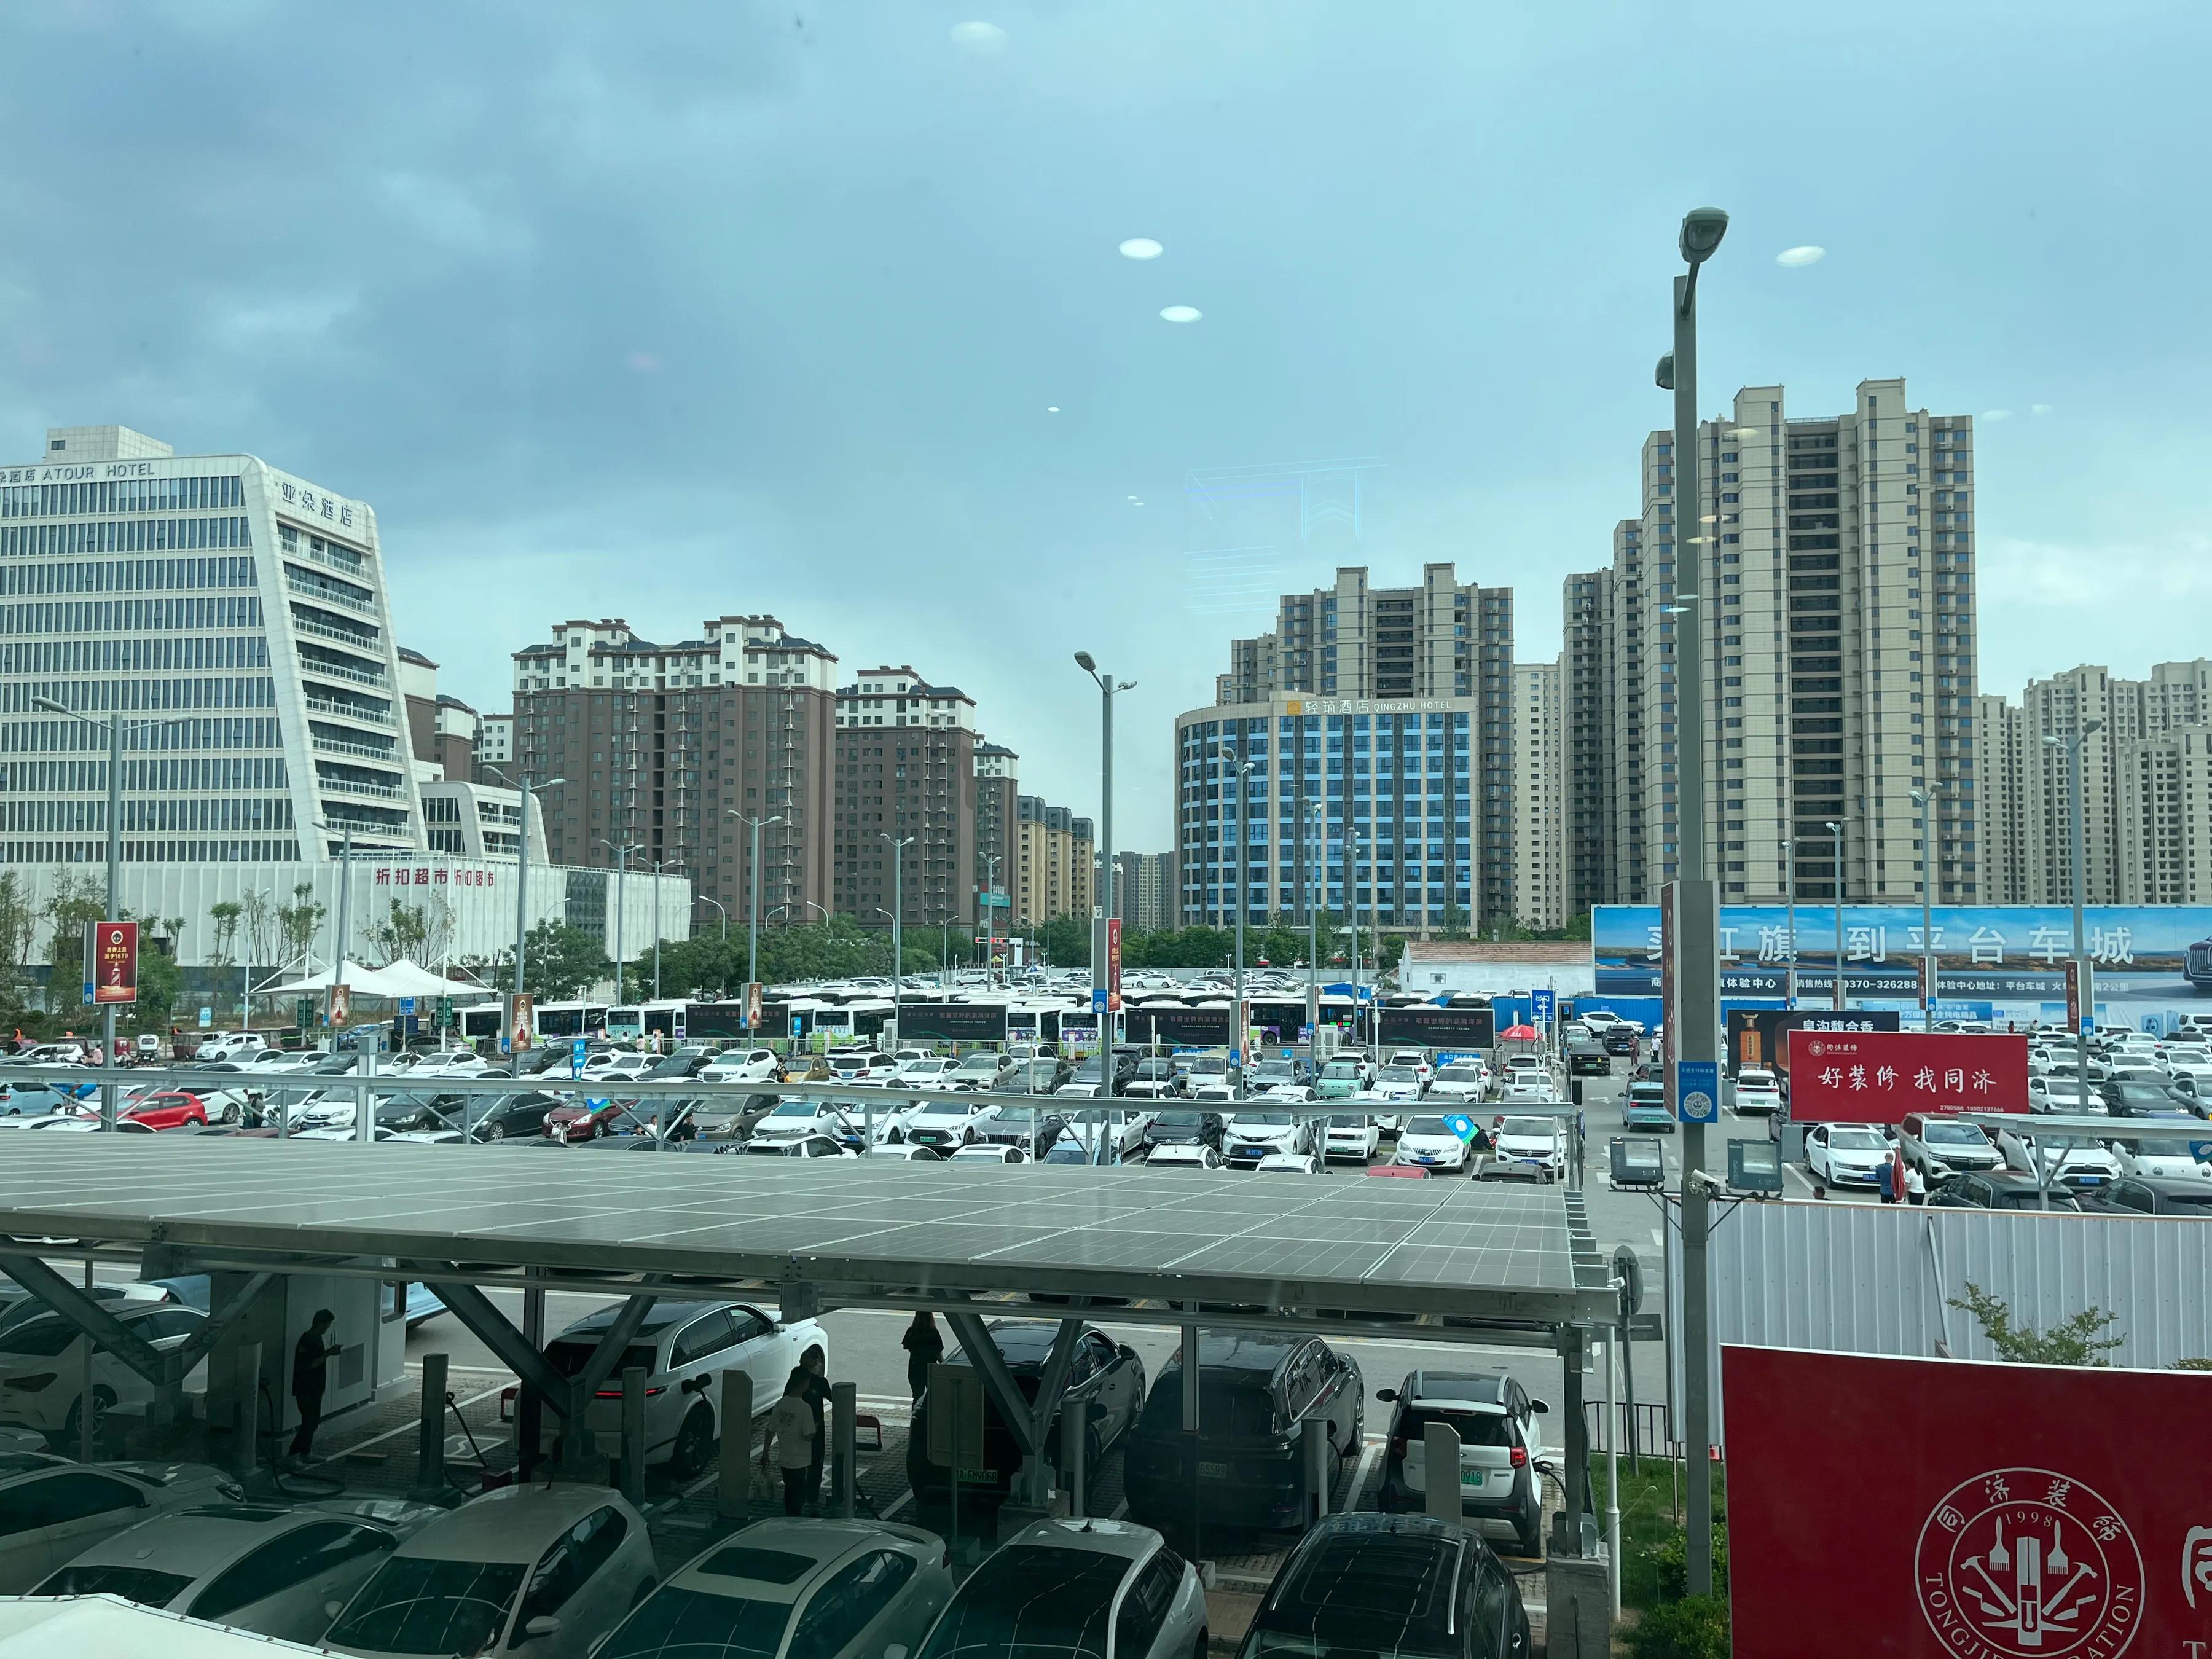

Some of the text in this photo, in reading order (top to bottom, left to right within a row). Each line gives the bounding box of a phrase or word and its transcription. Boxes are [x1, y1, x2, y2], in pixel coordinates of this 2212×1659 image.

[42, 467, 94, 481] ATOUR
[108, 463, 155, 477] HOTEL
[282, 481, 353, 527] 亚朵酒店
[1373, 702, 1416, 713] QINGZHU
[1420, 701, 1451, 710] HOTEL
[376, 868, 448, 885] 折扣超市
[2006, 981, 2045, 990] 平台车城
[1818, 1064, 1998, 1095] 好装修 找同济
[1937, 1474, 2122, 1541] 同济装饰
[2005, 1511, 2052, 1527] 1998
